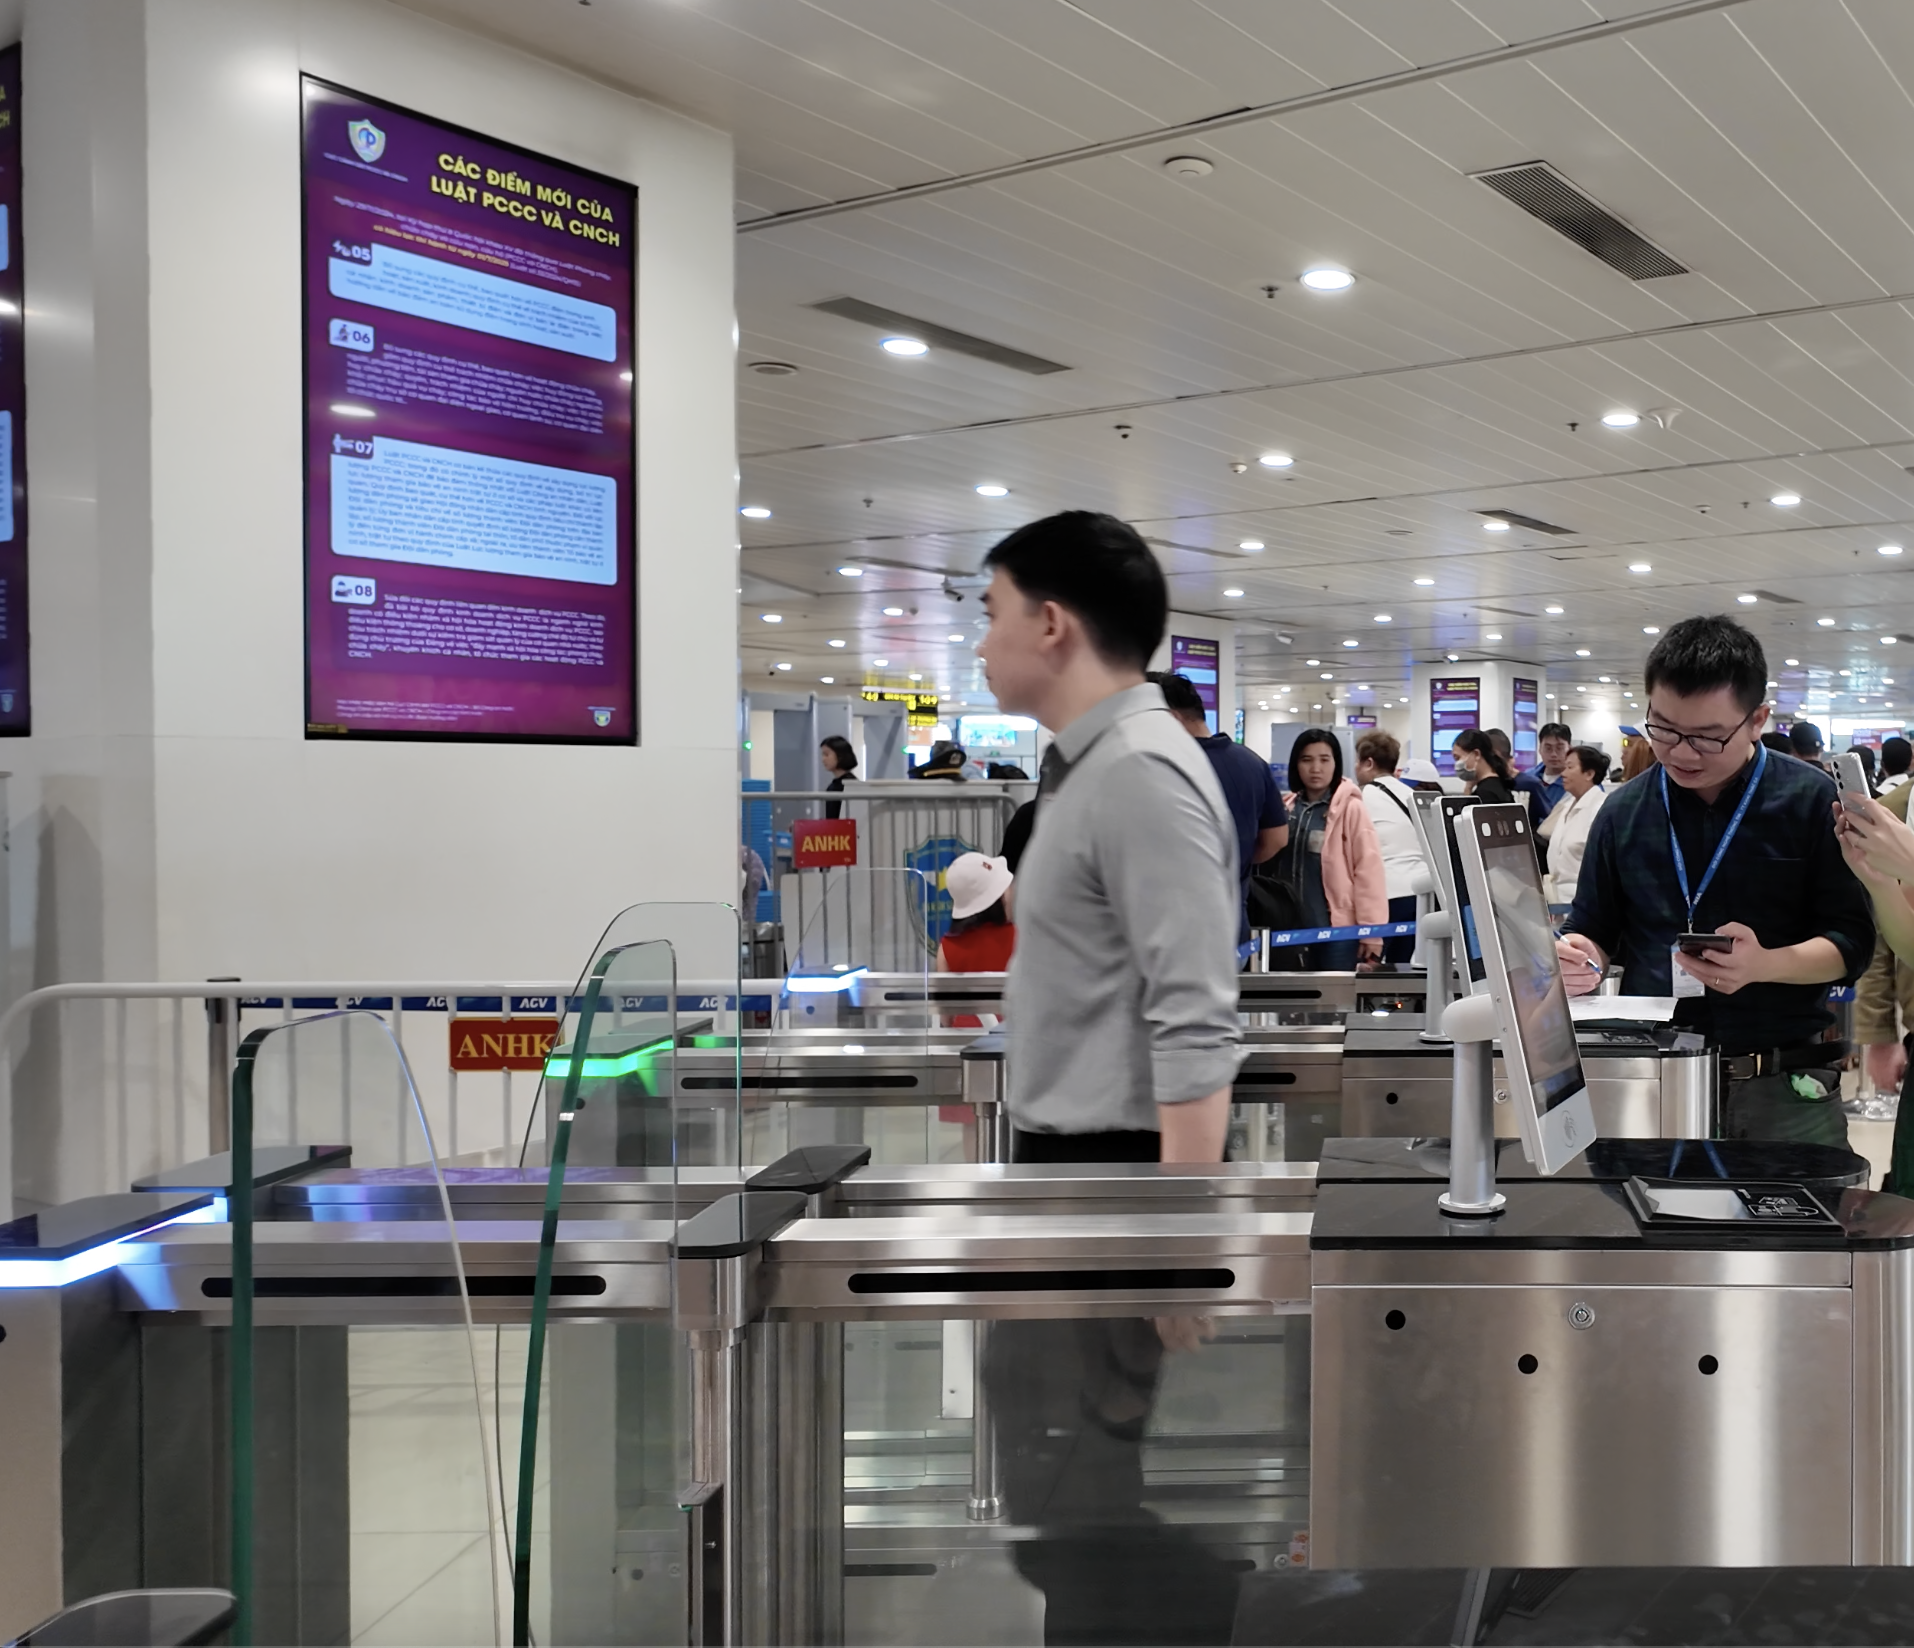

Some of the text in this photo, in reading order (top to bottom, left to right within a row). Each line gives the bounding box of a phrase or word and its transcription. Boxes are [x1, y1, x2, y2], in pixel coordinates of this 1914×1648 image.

[438, 153, 481, 180] CÁC
[486, 168, 531, 196] ĐIỂM
[536, 184, 572, 209] MỚI
[576, 199, 613, 223] CỦA
[431, 175, 620, 247] LUẬT PCCC VÀ CNCH
[352, 246, 371, 262] 05
[353, 330, 370, 344] 06
[355, 441, 373, 455] 07
[355, 585, 373, 597] 08
[802, 834, 851, 852] ANHK
[1276, 933, 1291, 943] ACV
[1317, 930, 1331, 939] ACV
[1358, 927, 1371, 936] ACV
[426, 997, 449, 1008] AC
[518, 997, 548, 1009] ACV
[620, 997, 643, 1008] CV
[456, 1034, 556, 1058] ANHK
